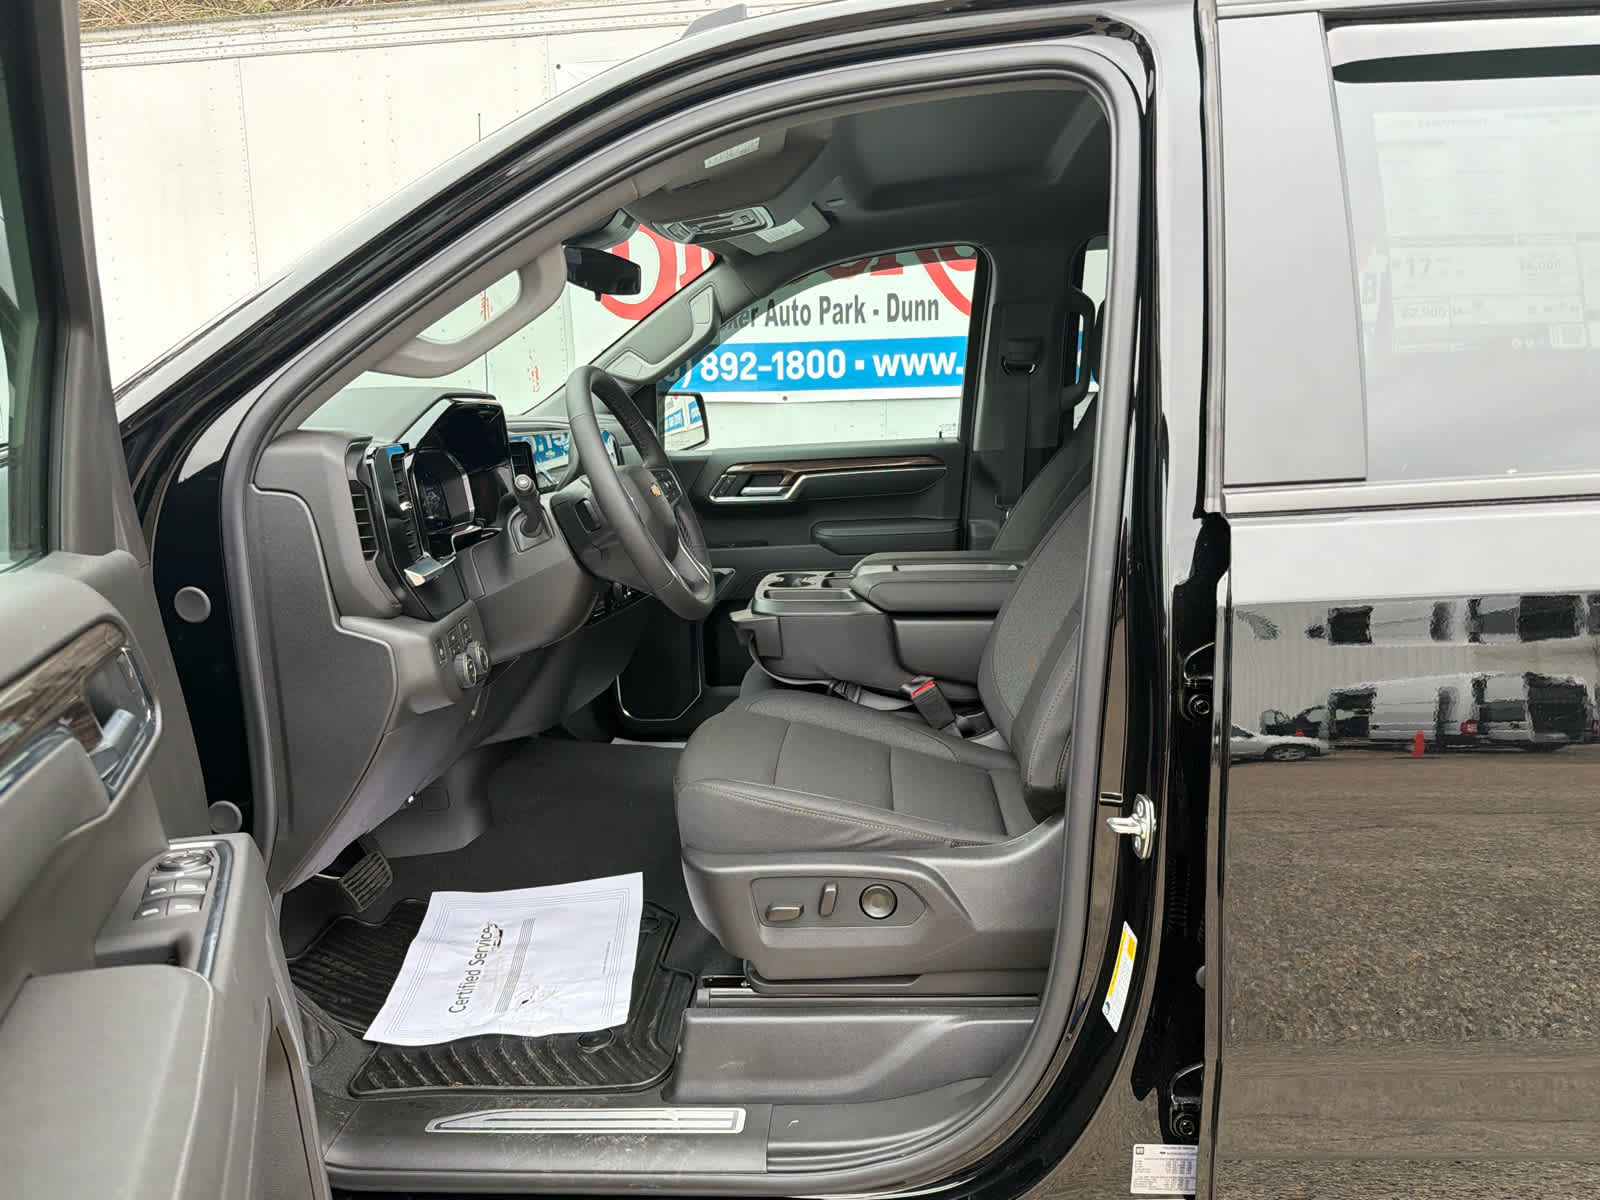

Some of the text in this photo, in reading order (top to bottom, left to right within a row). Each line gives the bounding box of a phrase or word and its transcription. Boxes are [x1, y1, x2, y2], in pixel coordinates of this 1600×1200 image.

[765, 298, 811, 327] Auto
[819, 295, 866, 325] Park
[887, 293, 939, 323] Dunn
[700, 349, 846, 382] 892-1800
[872, 352, 964, 377] www.
[448, 926, 493, 1014] Certified Service
